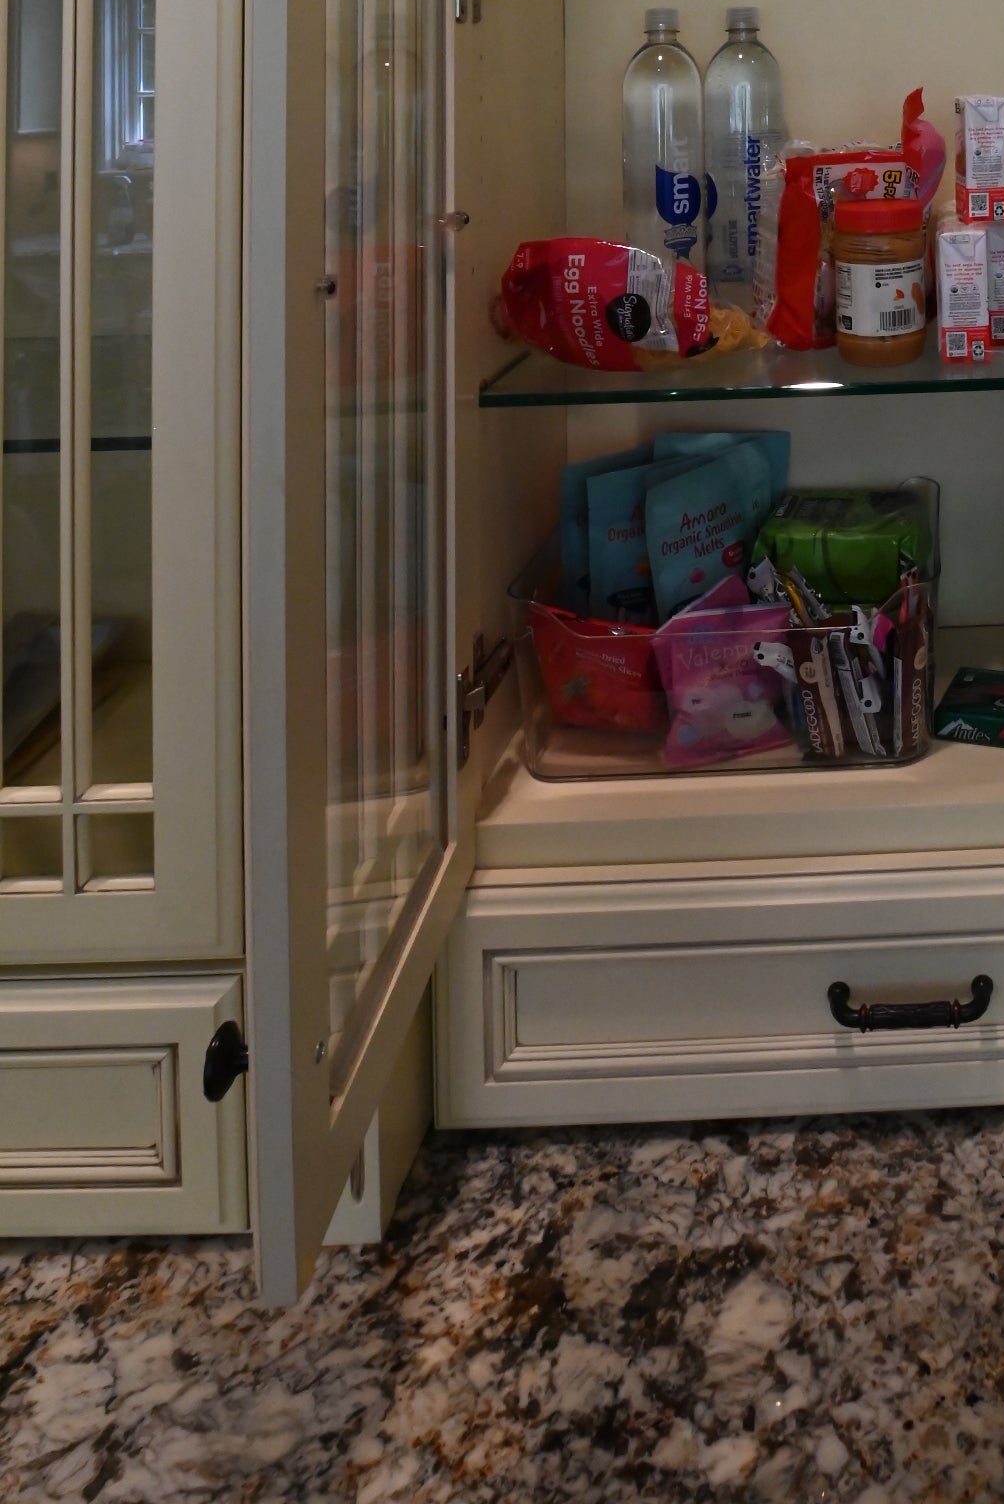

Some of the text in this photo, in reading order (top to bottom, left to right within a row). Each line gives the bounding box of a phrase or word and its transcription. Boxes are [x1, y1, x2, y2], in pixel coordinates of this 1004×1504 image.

[742, 135, 762, 257] smartwater
[563, 254, 600, 366] Egg Noodles
[587, 286, 605, 347] Extra Wide
[683, 294, 692, 318] Extra
[661, 531, 702, 556] Organic
[694, 538, 725, 559] Melts
[944, 720, 991, 742] Andes
